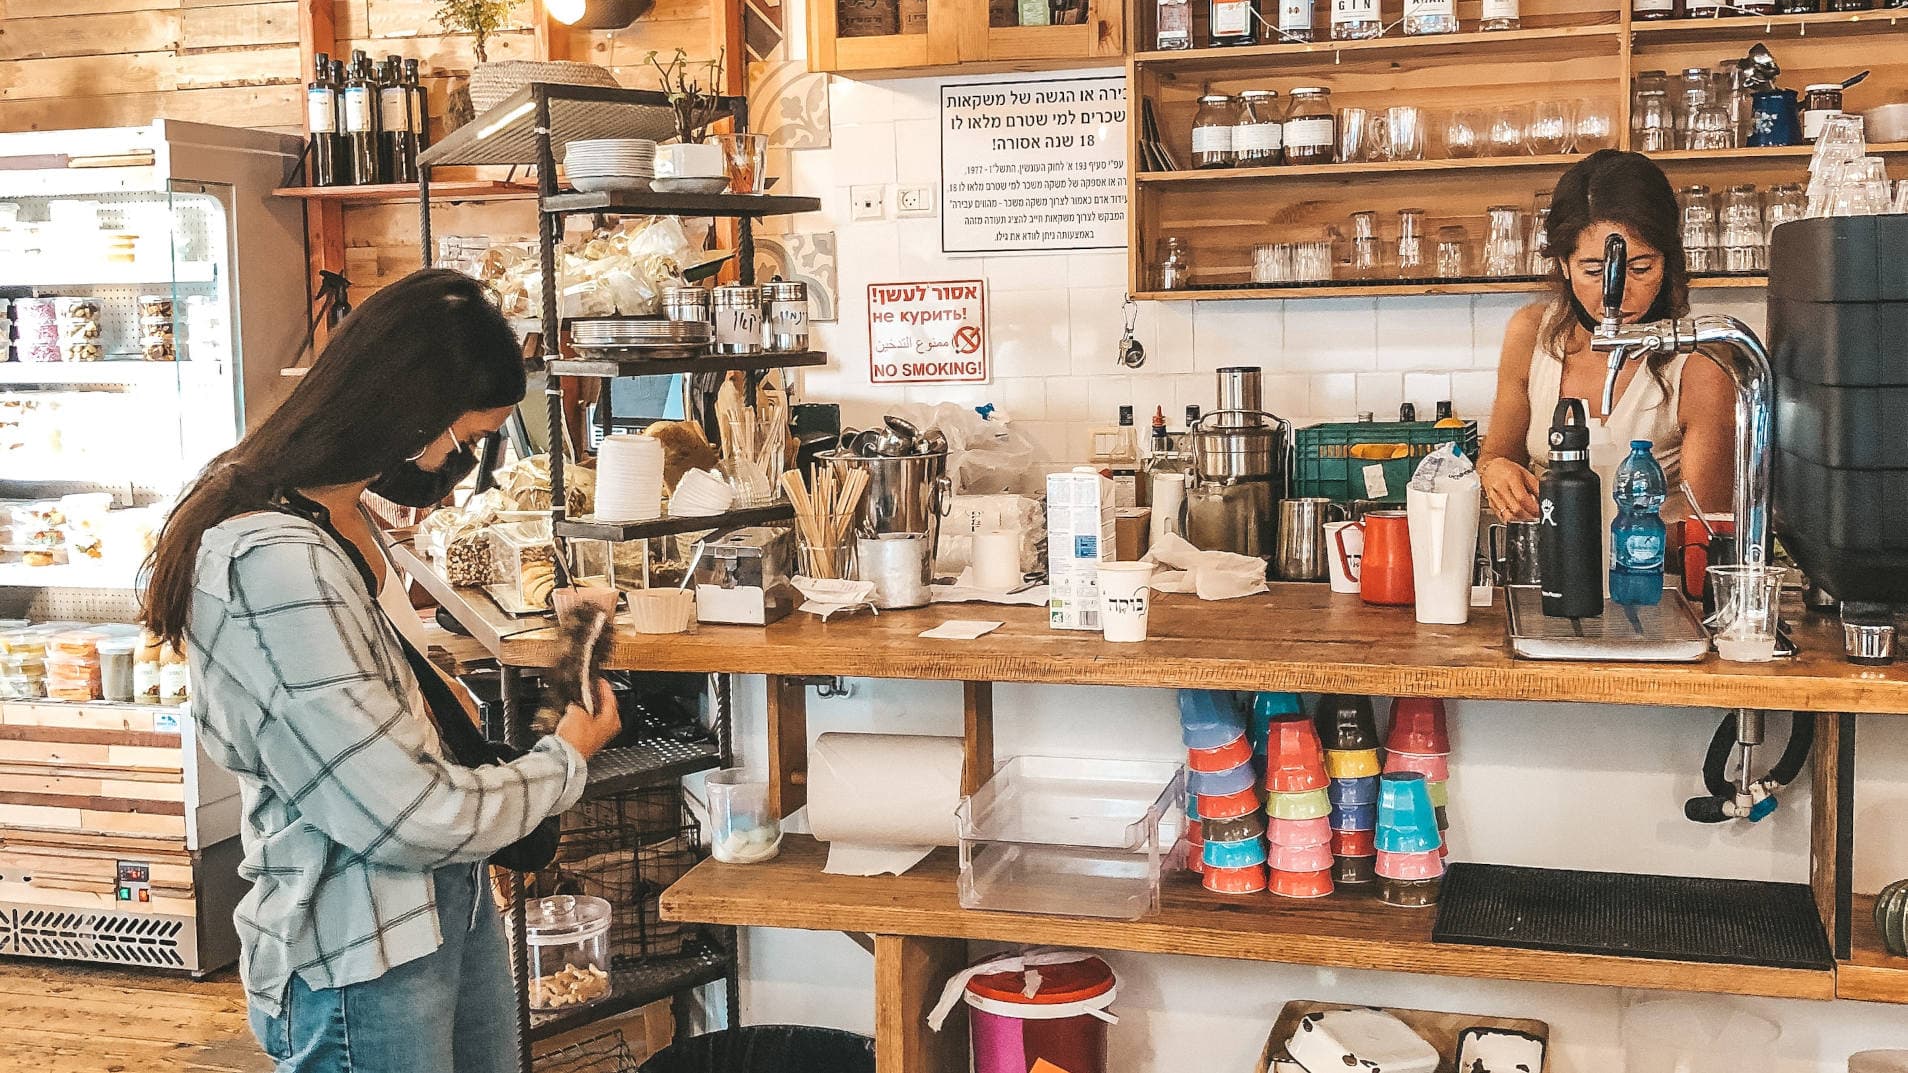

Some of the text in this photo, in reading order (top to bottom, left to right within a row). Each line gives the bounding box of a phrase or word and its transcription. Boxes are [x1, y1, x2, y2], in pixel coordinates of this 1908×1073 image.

[1338, 0, 1370, 10] GIN
[952, 114, 963, 130] לו
[968, 113, 1001, 129] מלאו
[1006, 114, 1048, 127] שטרם
[1053, 110, 1076, 126] למי
[992, 134, 1095, 151] 18 שנה אסורה!
[872, 286, 976, 305] אסור לעשן!
[873, 308, 967, 325] не курить!
[876, 337, 949, 353] ممنوع التدخين
[874, 362, 981, 377] NO SMOKING!
